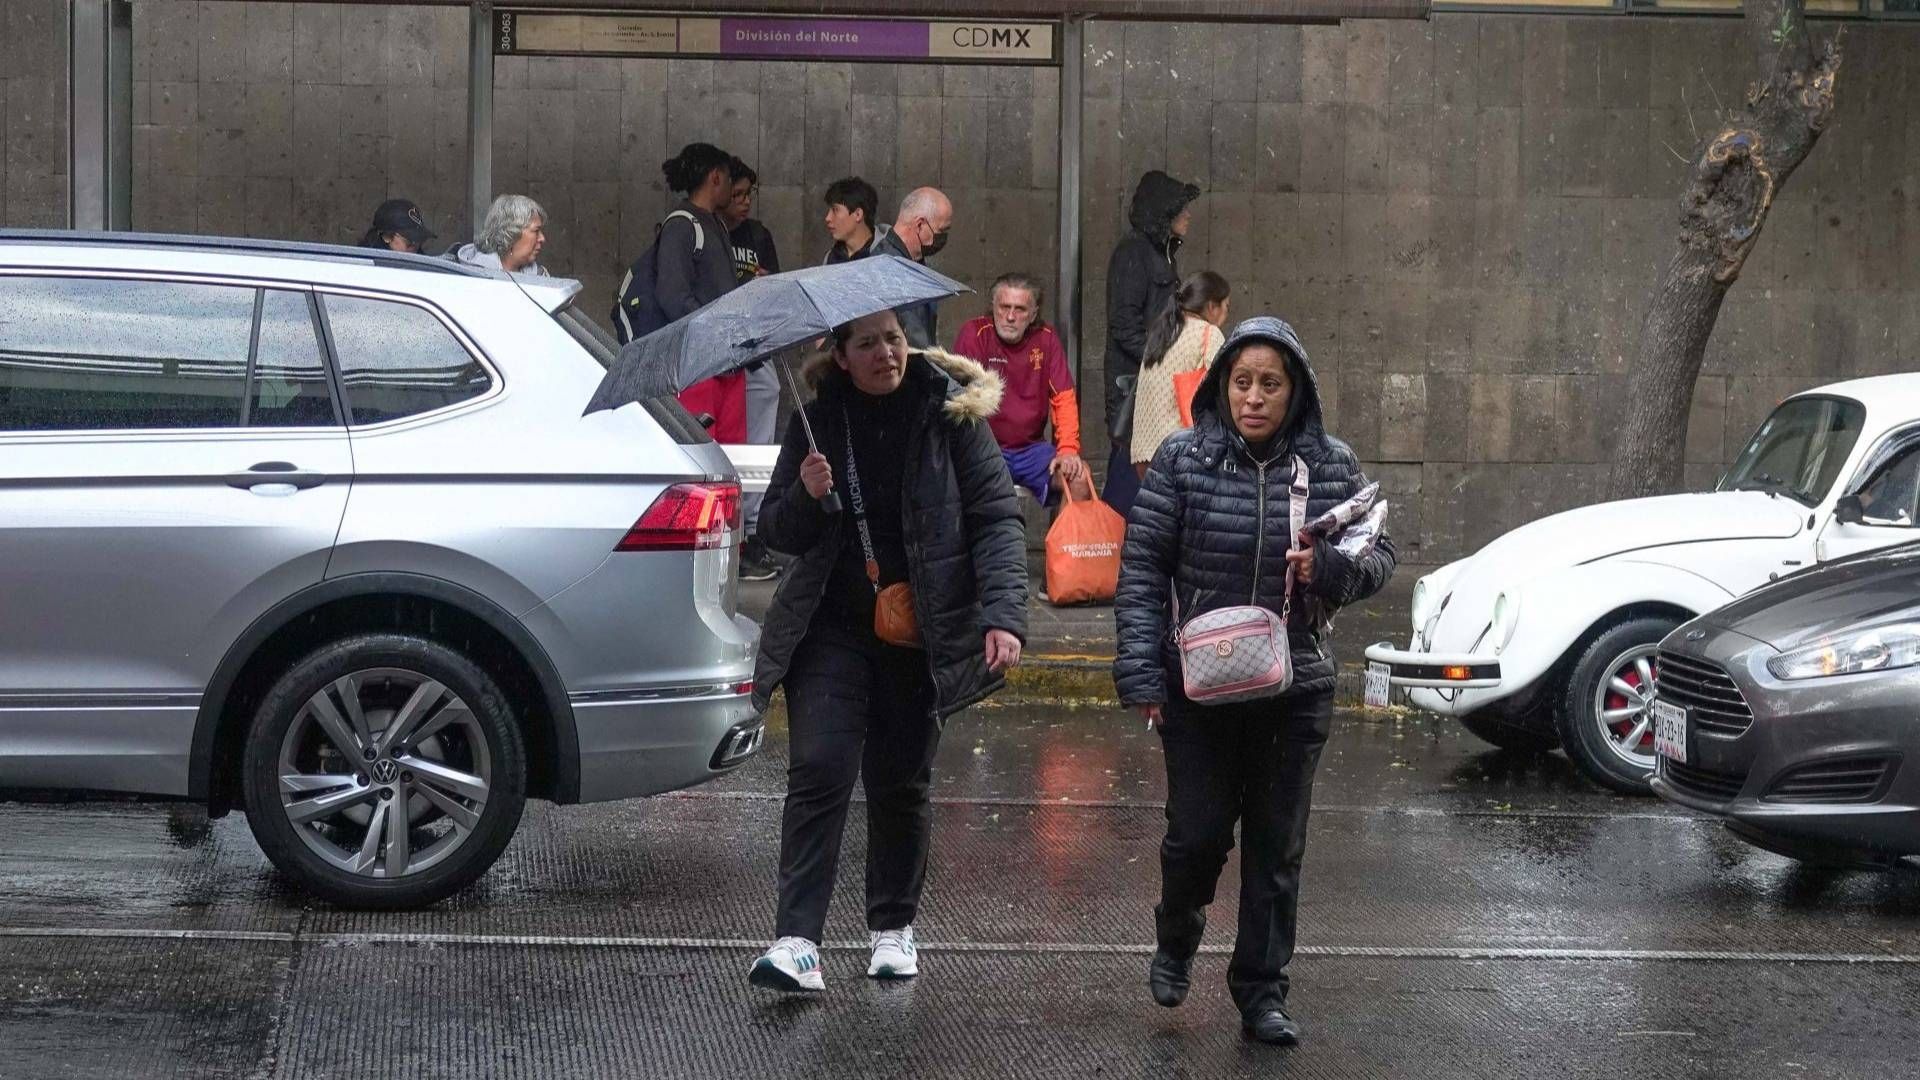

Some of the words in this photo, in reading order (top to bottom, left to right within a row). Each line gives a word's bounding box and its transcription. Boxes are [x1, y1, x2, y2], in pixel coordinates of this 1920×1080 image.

[501, 13, 512, 50] 30-063
[736, 29, 791, 41] División
[795, 30, 817, 42] del
[820, 31, 859, 42] Norte
[953, 26, 1031, 48] CDMX
